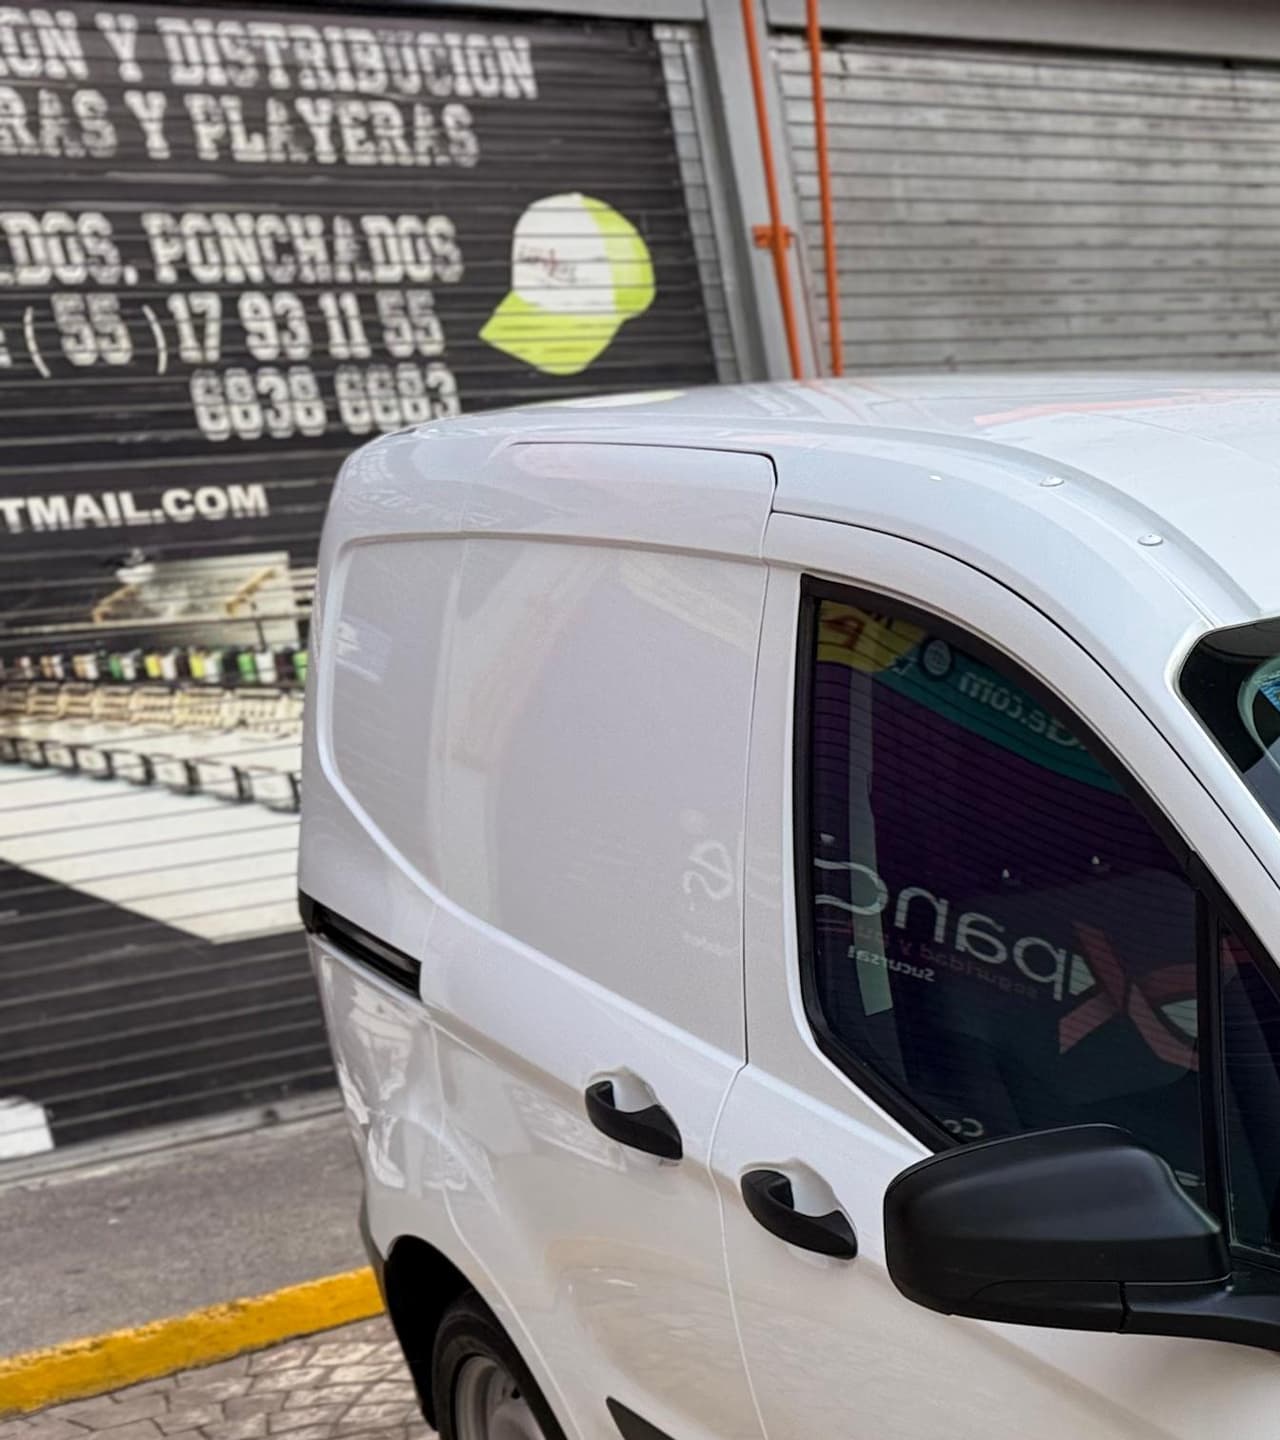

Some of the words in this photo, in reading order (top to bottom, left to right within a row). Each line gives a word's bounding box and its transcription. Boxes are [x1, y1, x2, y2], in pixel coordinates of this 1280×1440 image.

[95, 12, 143, 83] Y
[155, 17, 539, 99] DISTRIBUCION
[123, 90, 171, 160] Y
[183, 93, 480, 168] PLAYERAS
[0, 211, 139, 286] DOS.
[141, 211, 464, 283] PONCHADOS
[167, 291, 222, 363] 17
[237, 291, 311, 361] 93
[318, 291, 372, 359] 11
[375, 289, 446, 358] 55
